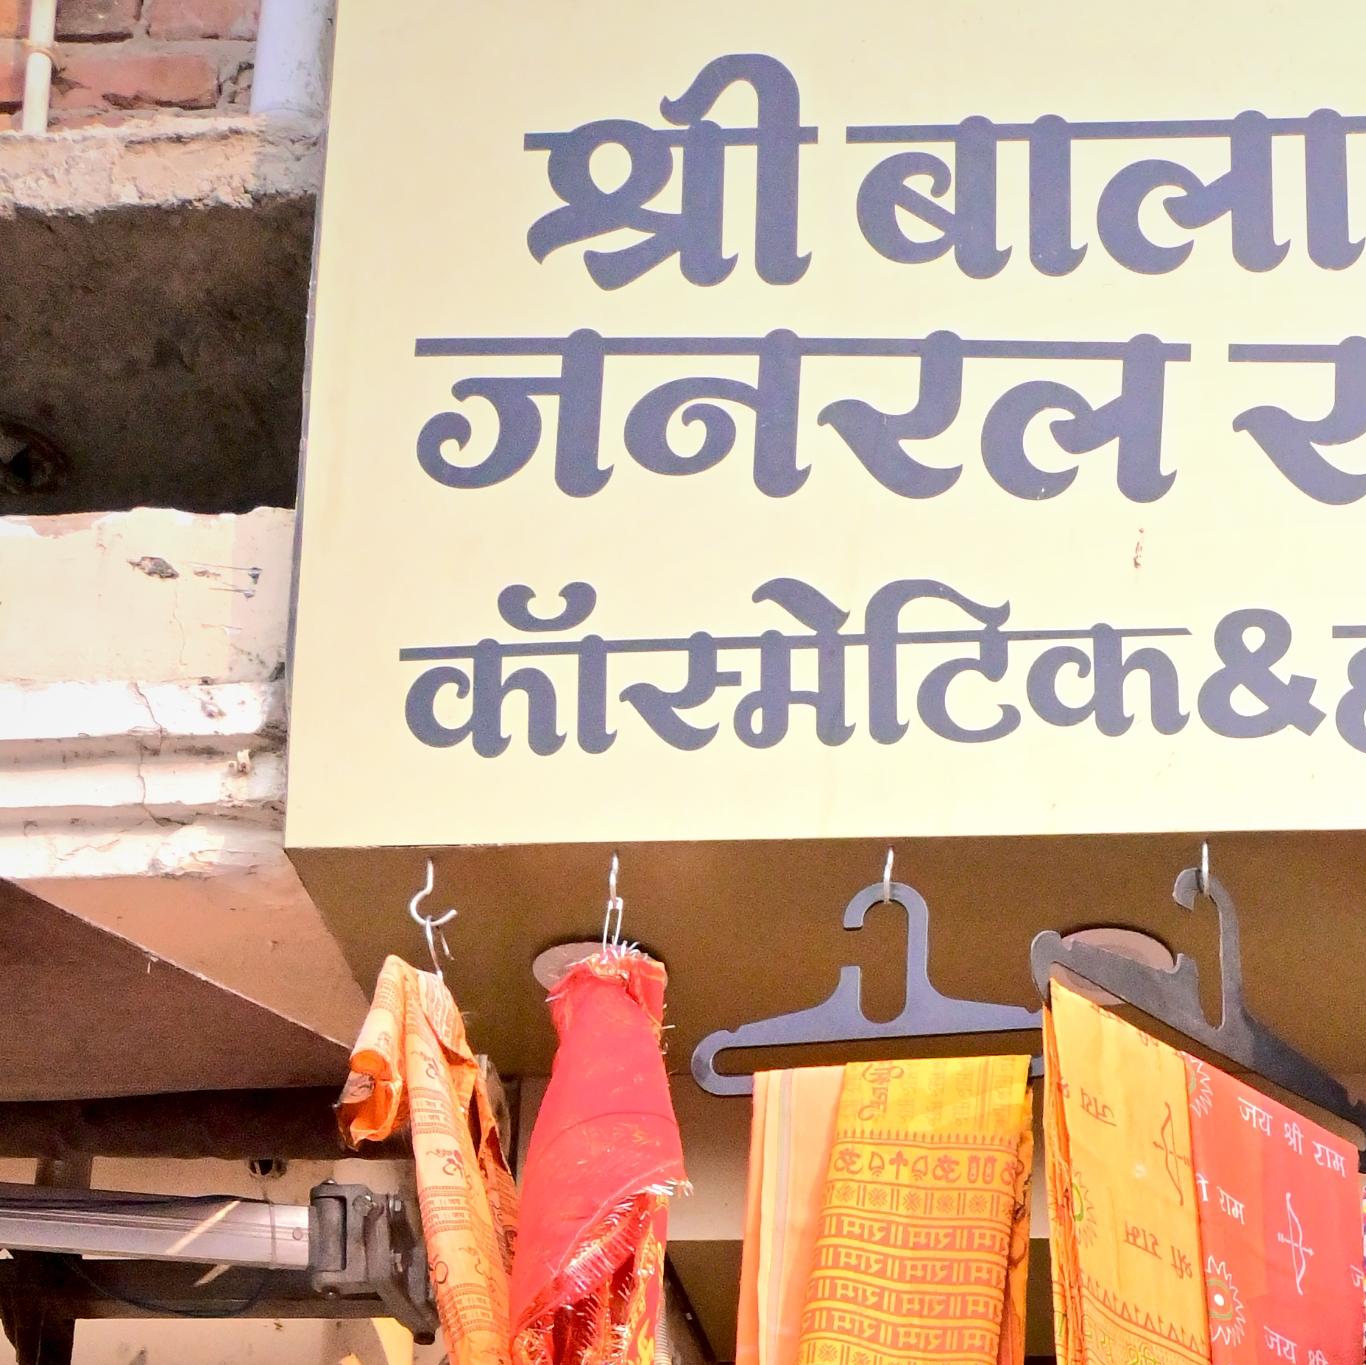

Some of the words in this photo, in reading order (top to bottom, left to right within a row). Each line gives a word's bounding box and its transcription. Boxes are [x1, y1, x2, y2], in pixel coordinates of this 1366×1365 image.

[524, 54, 818, 290] श्री
[415, 329, 1191, 503] जनरल
[1237, 1096, 1272, 1136] जय
[1284, 1122, 1304, 1155] श्री
[1312, 1141, 1346, 1177] राम
[1217, 1186, 1245, 1225] राम
[1264, 1326, 1297, 1364] जय
